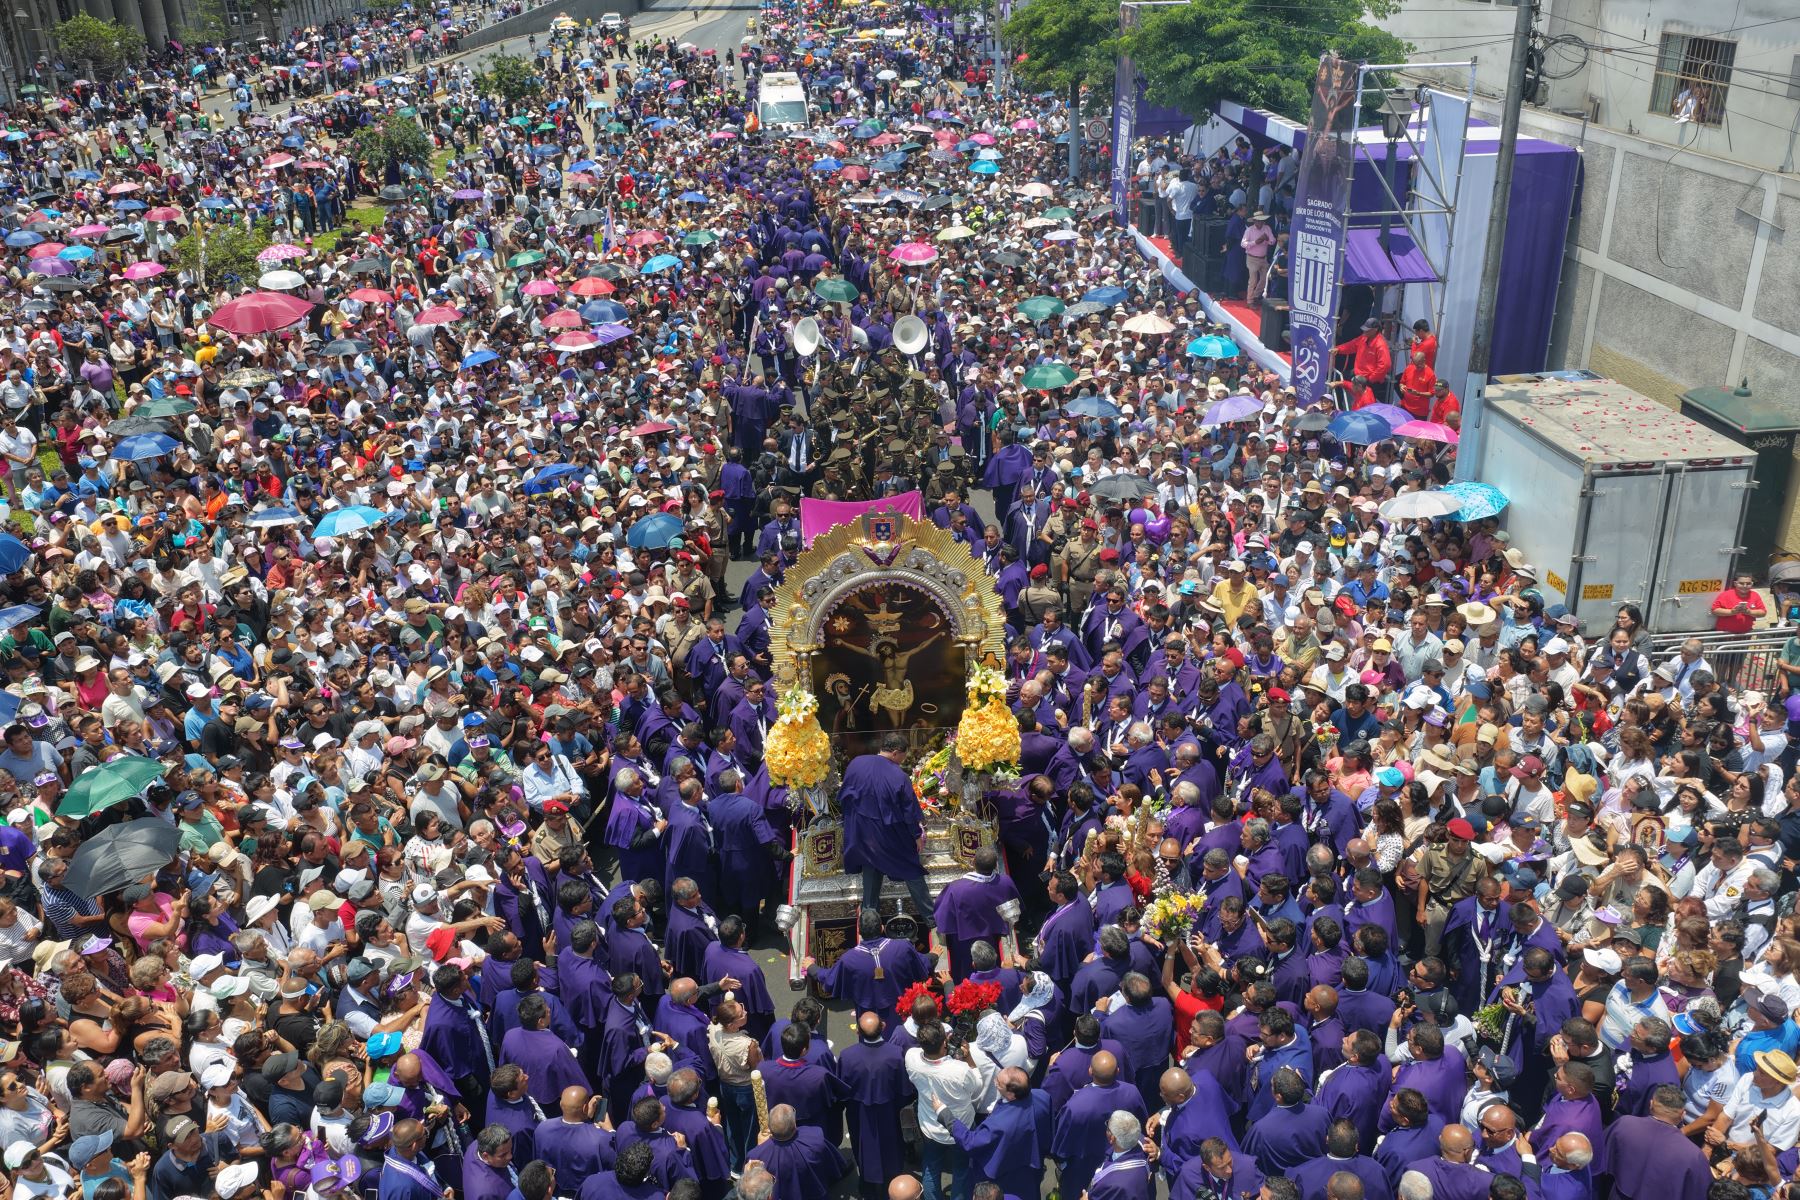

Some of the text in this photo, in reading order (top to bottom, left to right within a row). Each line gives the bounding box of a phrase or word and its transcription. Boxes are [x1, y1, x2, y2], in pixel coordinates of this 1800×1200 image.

[1307, 199, 1333, 209] SAGRADO
[1307, 209, 1314, 217] DE
[1314, 210, 1325, 218] LOS
[1298, 233, 1334, 249] ALIANZA
[1305, 303, 1319, 313] 1901
[1294, 313, 1318, 327] HOMENAJE
[1294, 345, 1320, 384] 125
[172, 1119, 189, 1134] adidas
